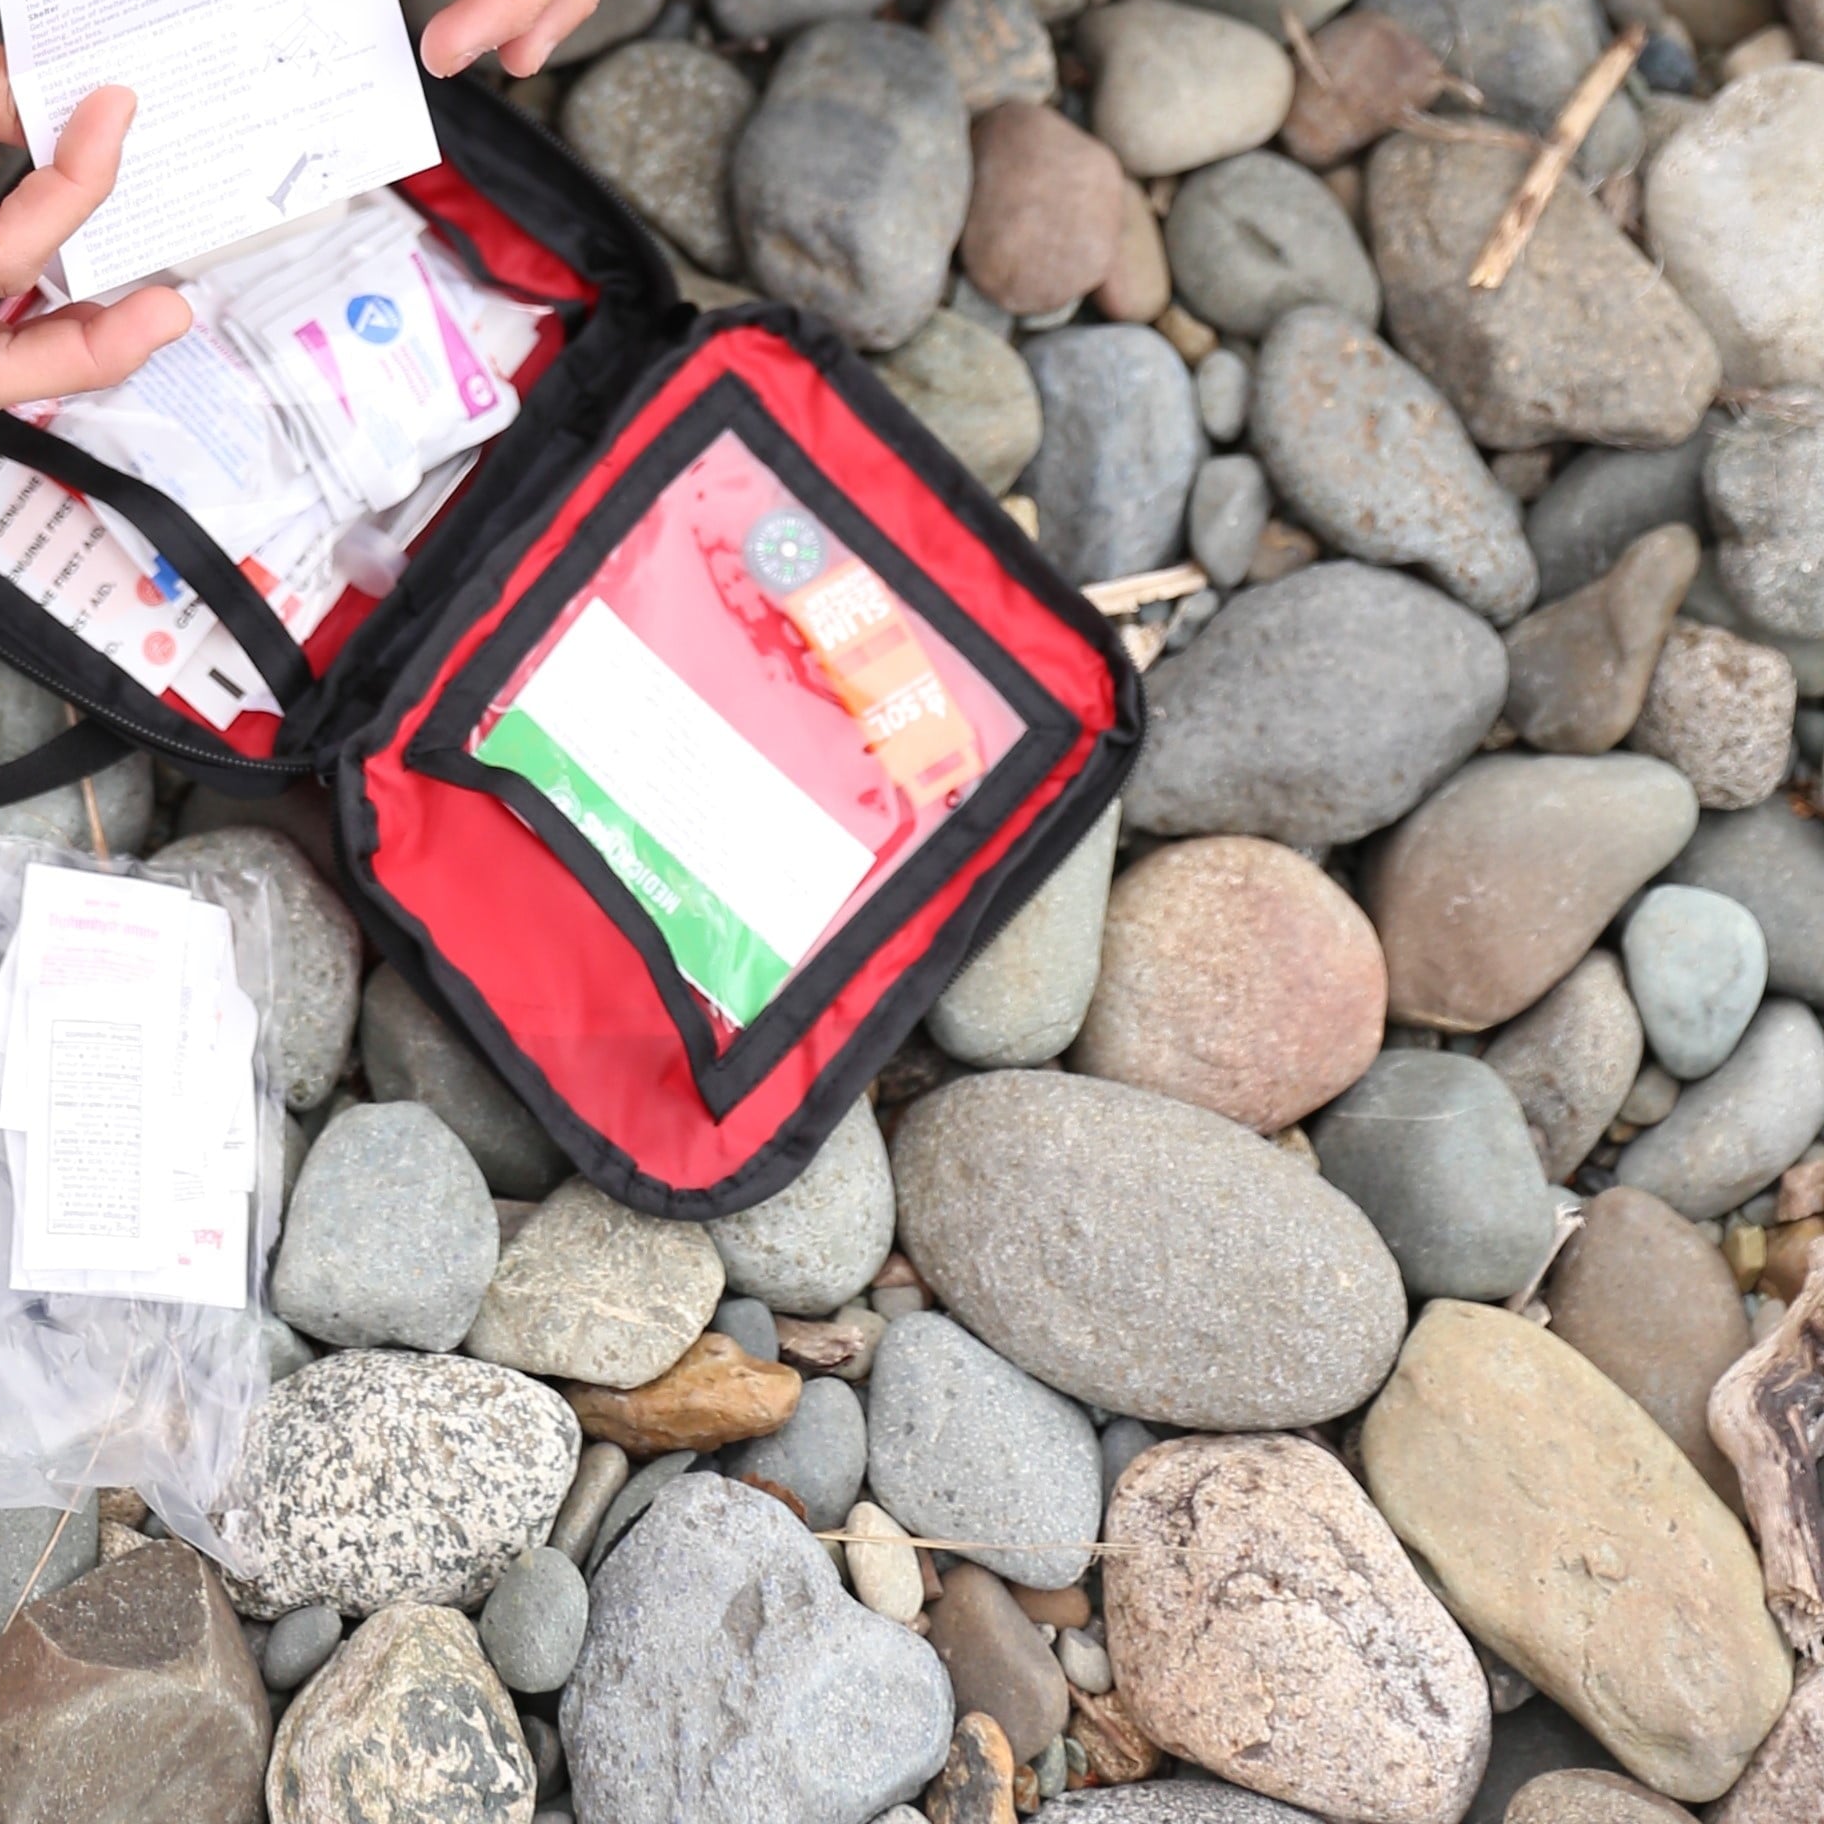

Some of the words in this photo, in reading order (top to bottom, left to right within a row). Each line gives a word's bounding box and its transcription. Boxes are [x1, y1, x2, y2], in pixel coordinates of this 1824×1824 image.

[8, 531, 50, 584] ENUINE
[46, 495, 74, 532] FIRST
[54, 552, 82, 590] FIRST
[91, 581, 116, 608] AID.
[866, 694, 924, 739] SOL
